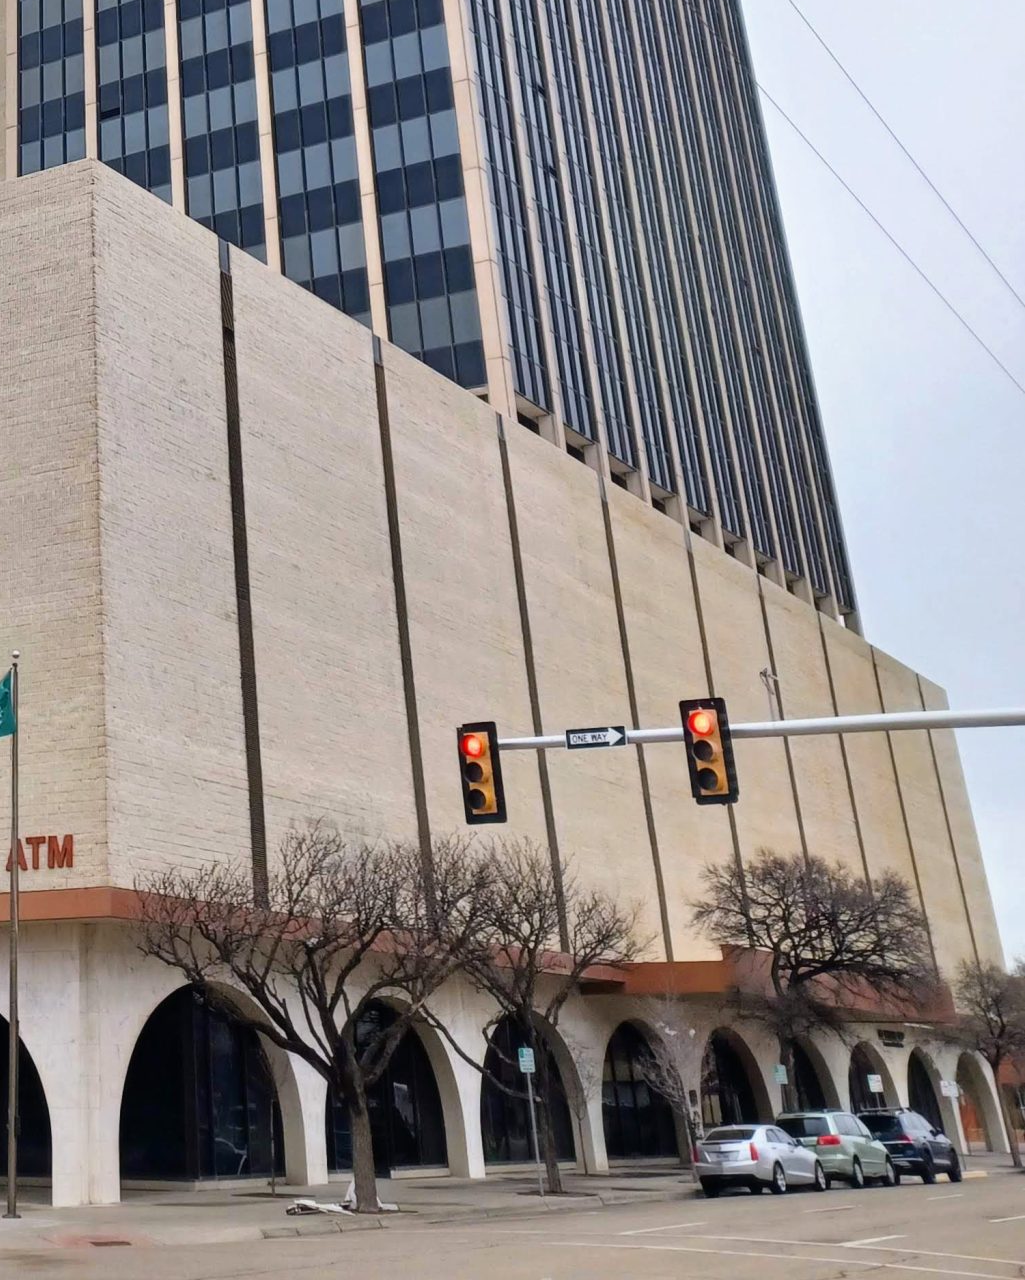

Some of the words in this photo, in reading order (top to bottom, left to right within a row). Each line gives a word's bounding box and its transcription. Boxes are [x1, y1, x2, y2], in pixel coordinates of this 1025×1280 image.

[572, 735, 589, 743] ONE
[590, 733, 607, 742] WAY
[6, 834, 73, 871] ATM
